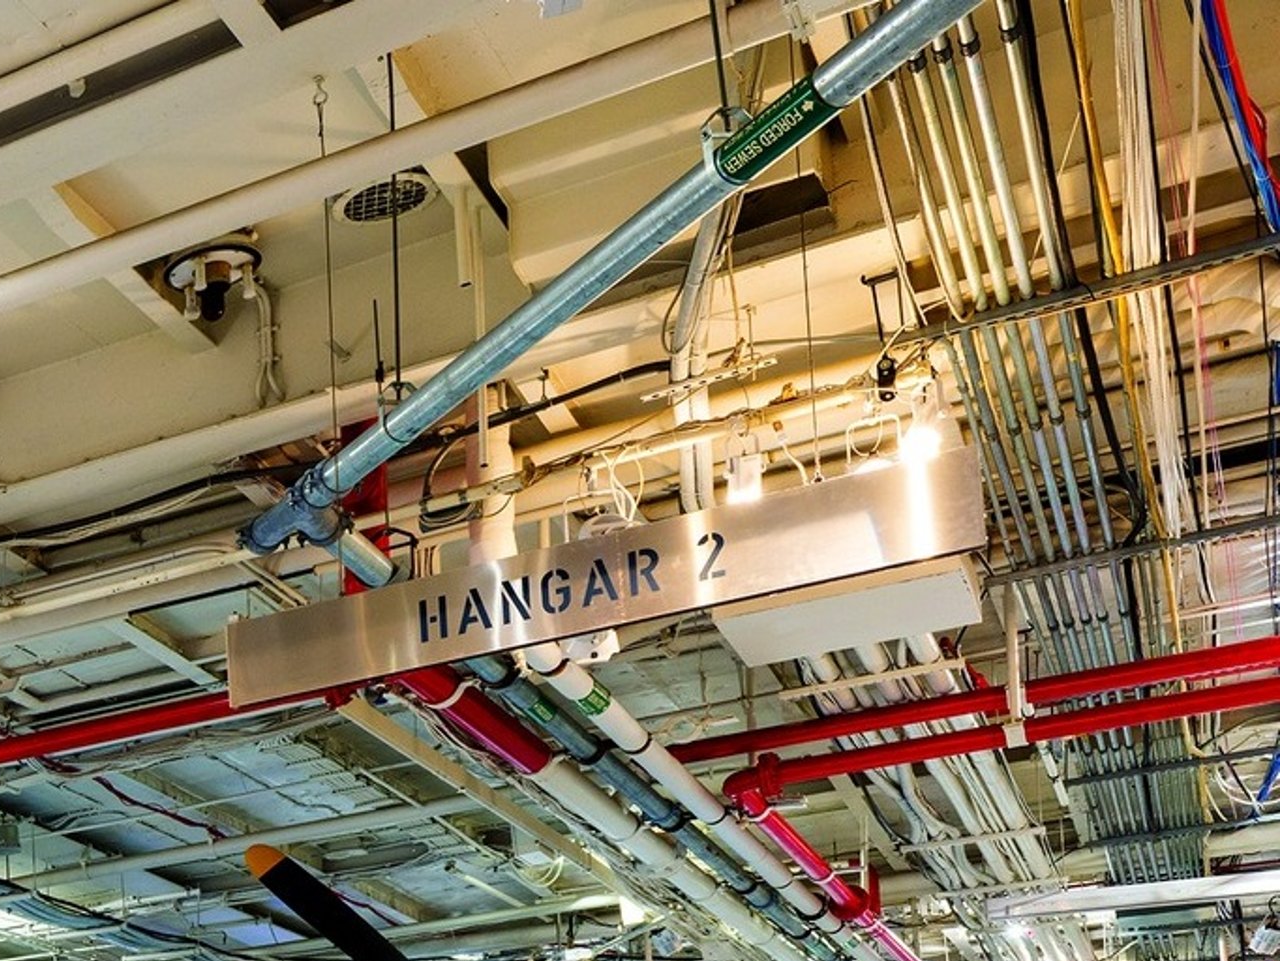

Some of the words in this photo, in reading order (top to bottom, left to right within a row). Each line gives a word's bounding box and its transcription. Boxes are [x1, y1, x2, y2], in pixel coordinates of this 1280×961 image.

[759, 107, 804, 147] FORCED
[723, 140, 764, 174] SEWER
[418, 548, 660, 643] HANGAR
[697, 531, 726, 582] 2
